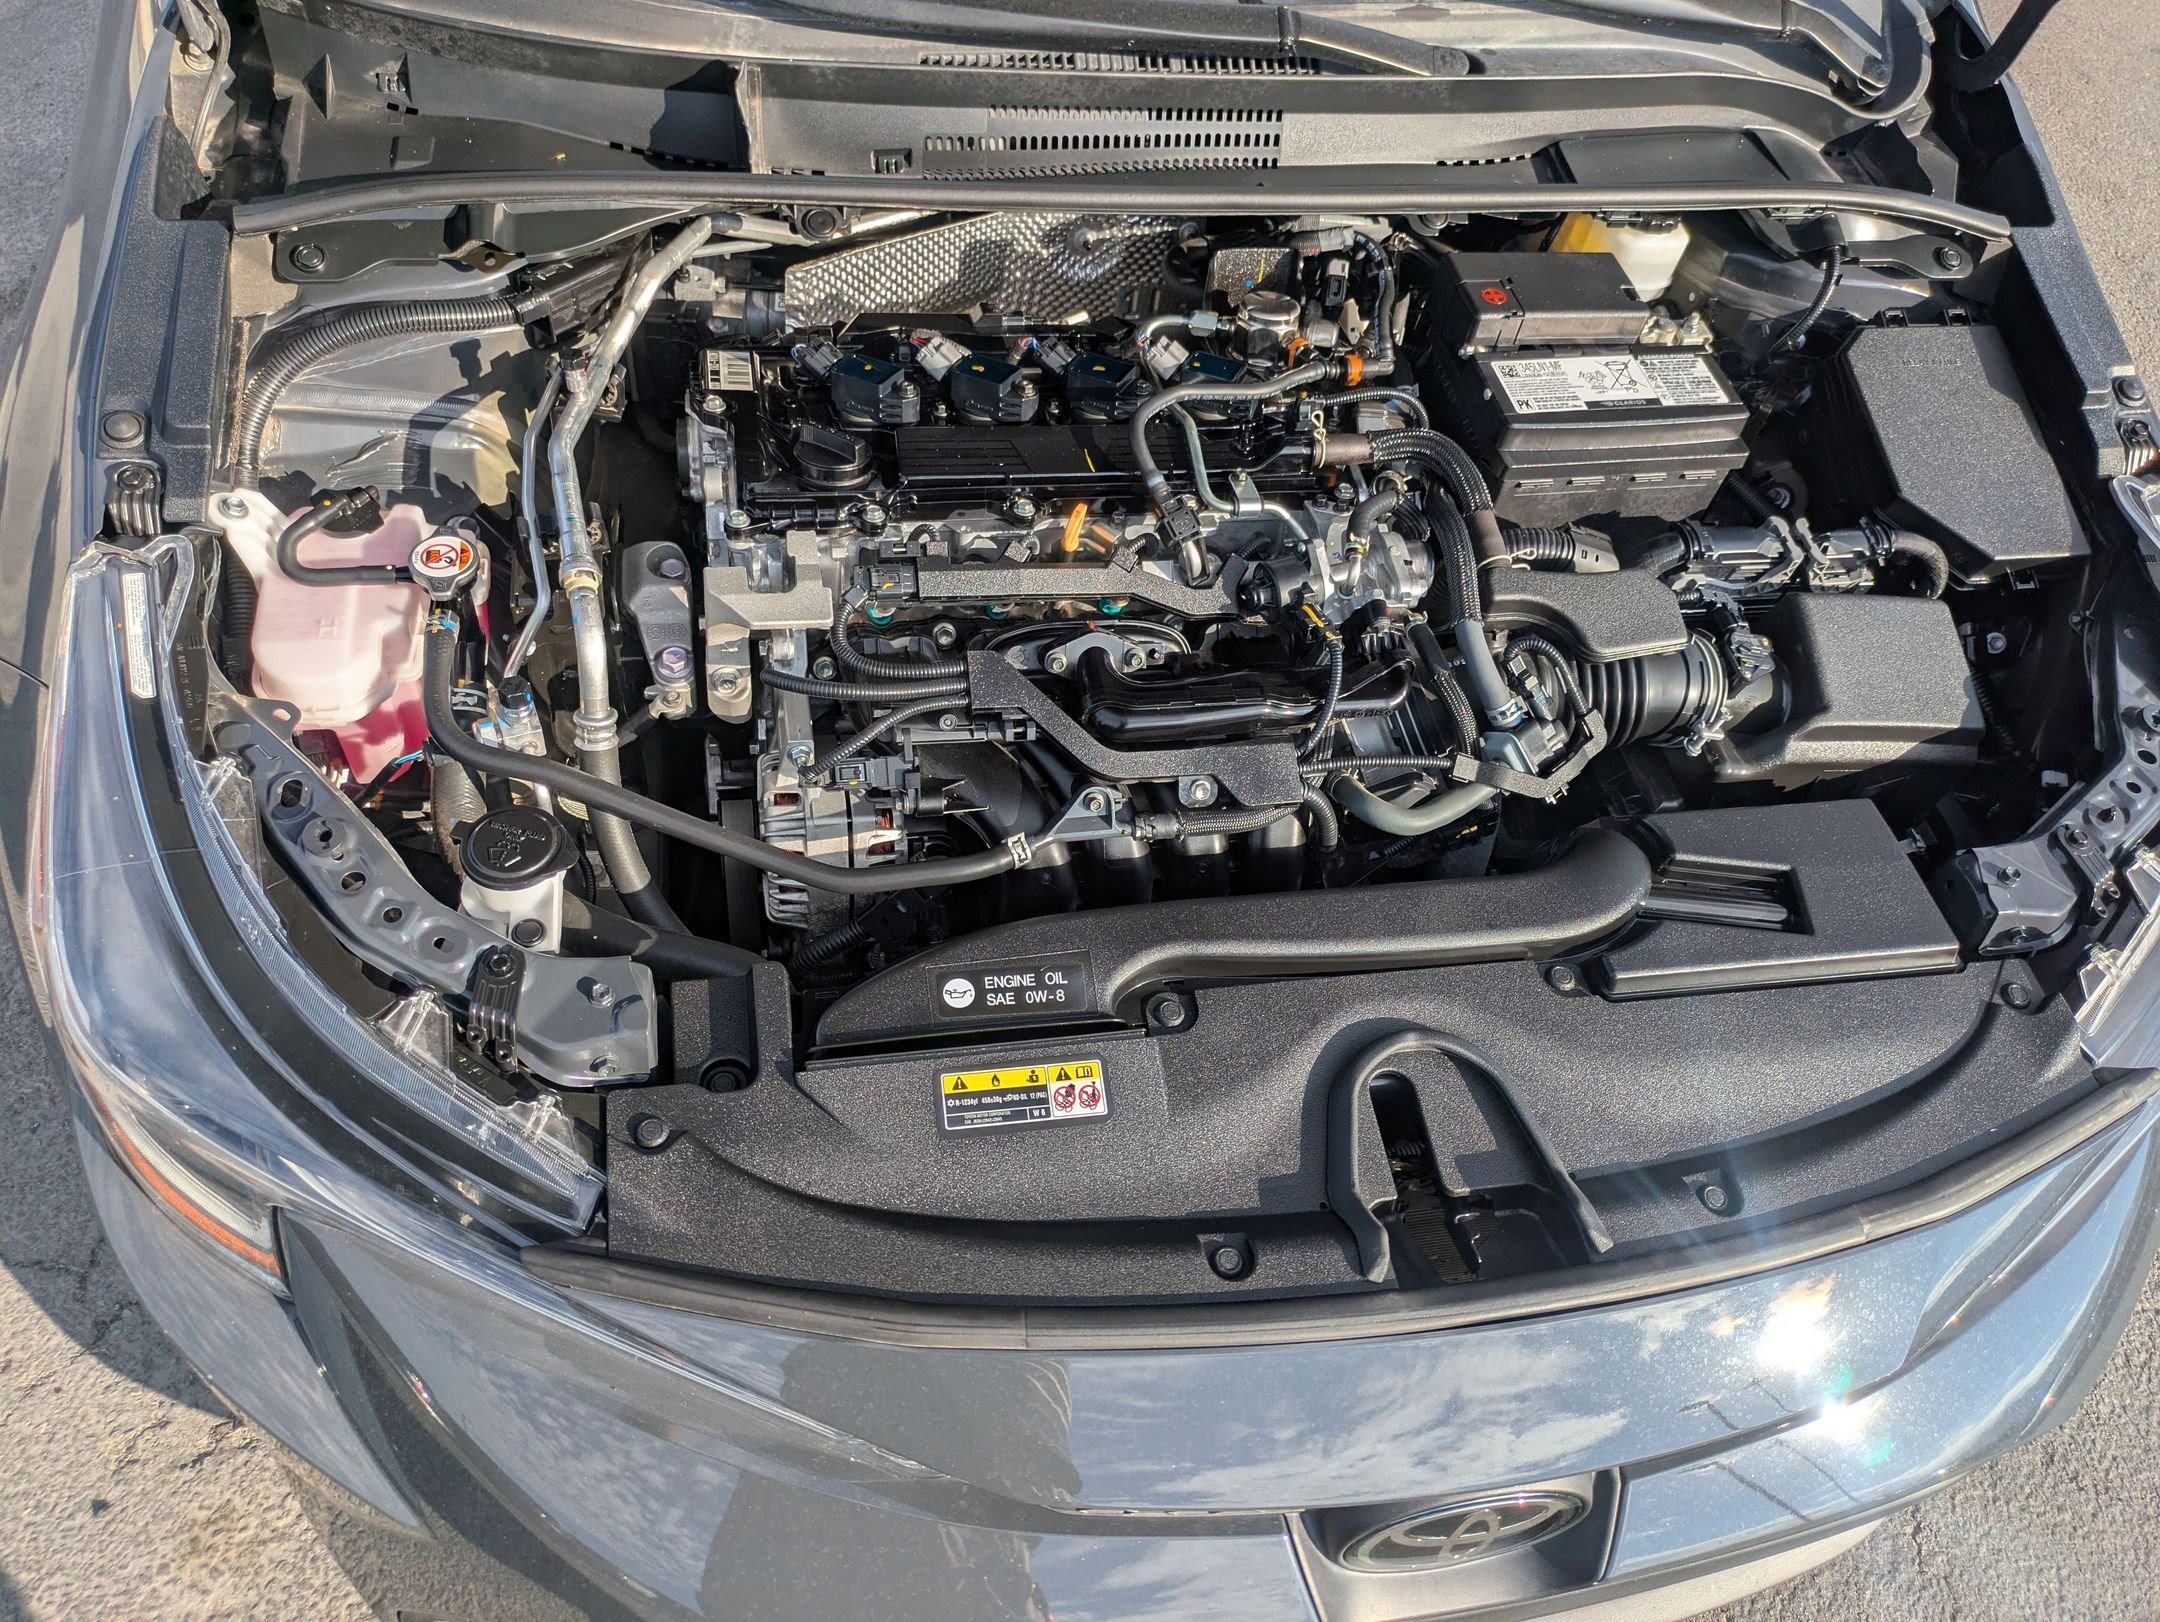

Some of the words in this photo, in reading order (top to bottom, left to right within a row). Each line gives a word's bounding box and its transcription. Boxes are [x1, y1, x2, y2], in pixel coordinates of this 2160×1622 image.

[1518, 398, 1533, 411] PK
[984, 973, 1036, 989] ENGINE
[1044, 971, 1069, 985] OIL
[986, 992, 1016, 1006] SAE
[1025, 989, 1066, 1004] 0W-8
[1033, 1109, 1040, 1117] W
[1041, 1108, 1046, 1116] 6
